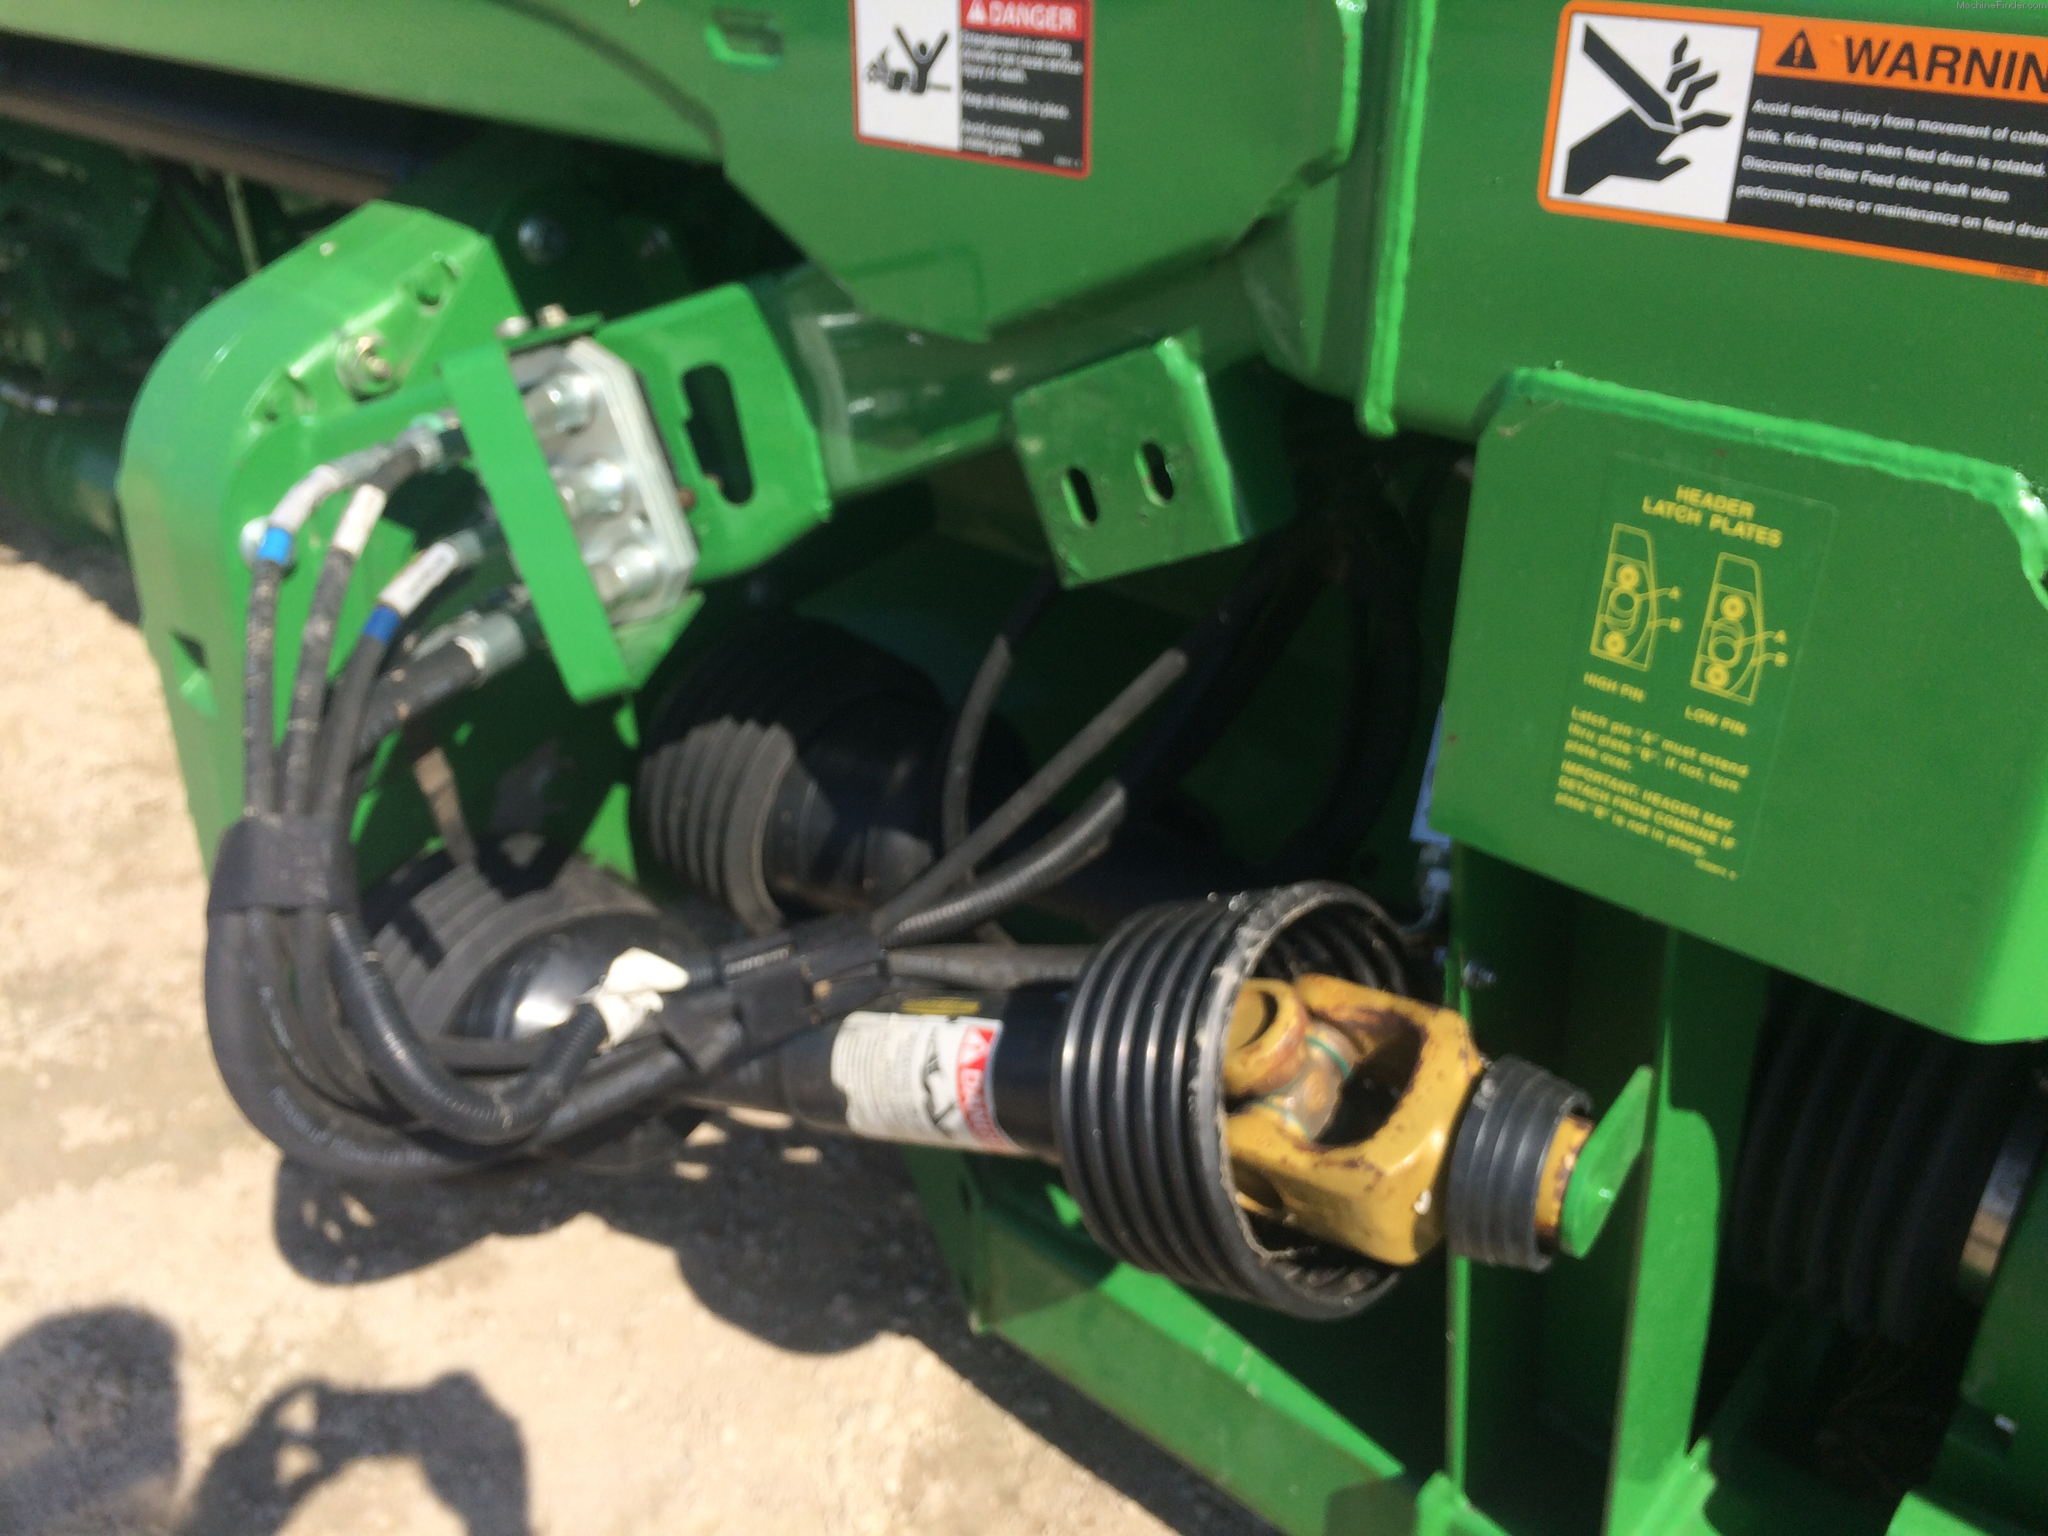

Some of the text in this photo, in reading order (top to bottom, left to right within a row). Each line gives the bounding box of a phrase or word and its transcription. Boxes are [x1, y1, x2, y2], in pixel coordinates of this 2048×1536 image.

[989, 1, 1077, 33] DANGER
[1752, 99, 1791, 116] Avoid
[1791, 105, 1841, 122] serious
[1842, 108, 1882, 130] injury
[1883, 113, 1916, 130] from
[1916, 119, 1992, 139] movement
[1992, 126, 2010, 142] of
[1784, 131, 1820, 149] Knife
[1820, 138, 1865, 155] moves
[1866, 142, 1904, 159] when
[1905, 145, 1937, 164] feed
[1938, 150, 1976, 168] drum
[1976, 154, 1991, 170] is
[1992, 158, 2047, 177] rotated.
[1742, 154, 2010, 204] Disconnect Center Feed drive shaft when
[1736, 185, 1807, 208] performing
[1807, 194, 1856, 212] service
[1856, 200, 1874, 214] or
[1873, 203, 1961, 228] maintenance
[1962, 216, 1982, 230] on
[1983, 216, 2016, 235] feed
[1676, 484, 1755, 520] HEADER
[1642, 496, 1782, 548] LATCH PLATES
[1583, 671, 1646, 703] HIGH PIN
[1684, 704, 1747, 737] LOW PIN
[1612, 795, 1652, 820] FROM
[1642, 789, 1700, 821] HEADER
